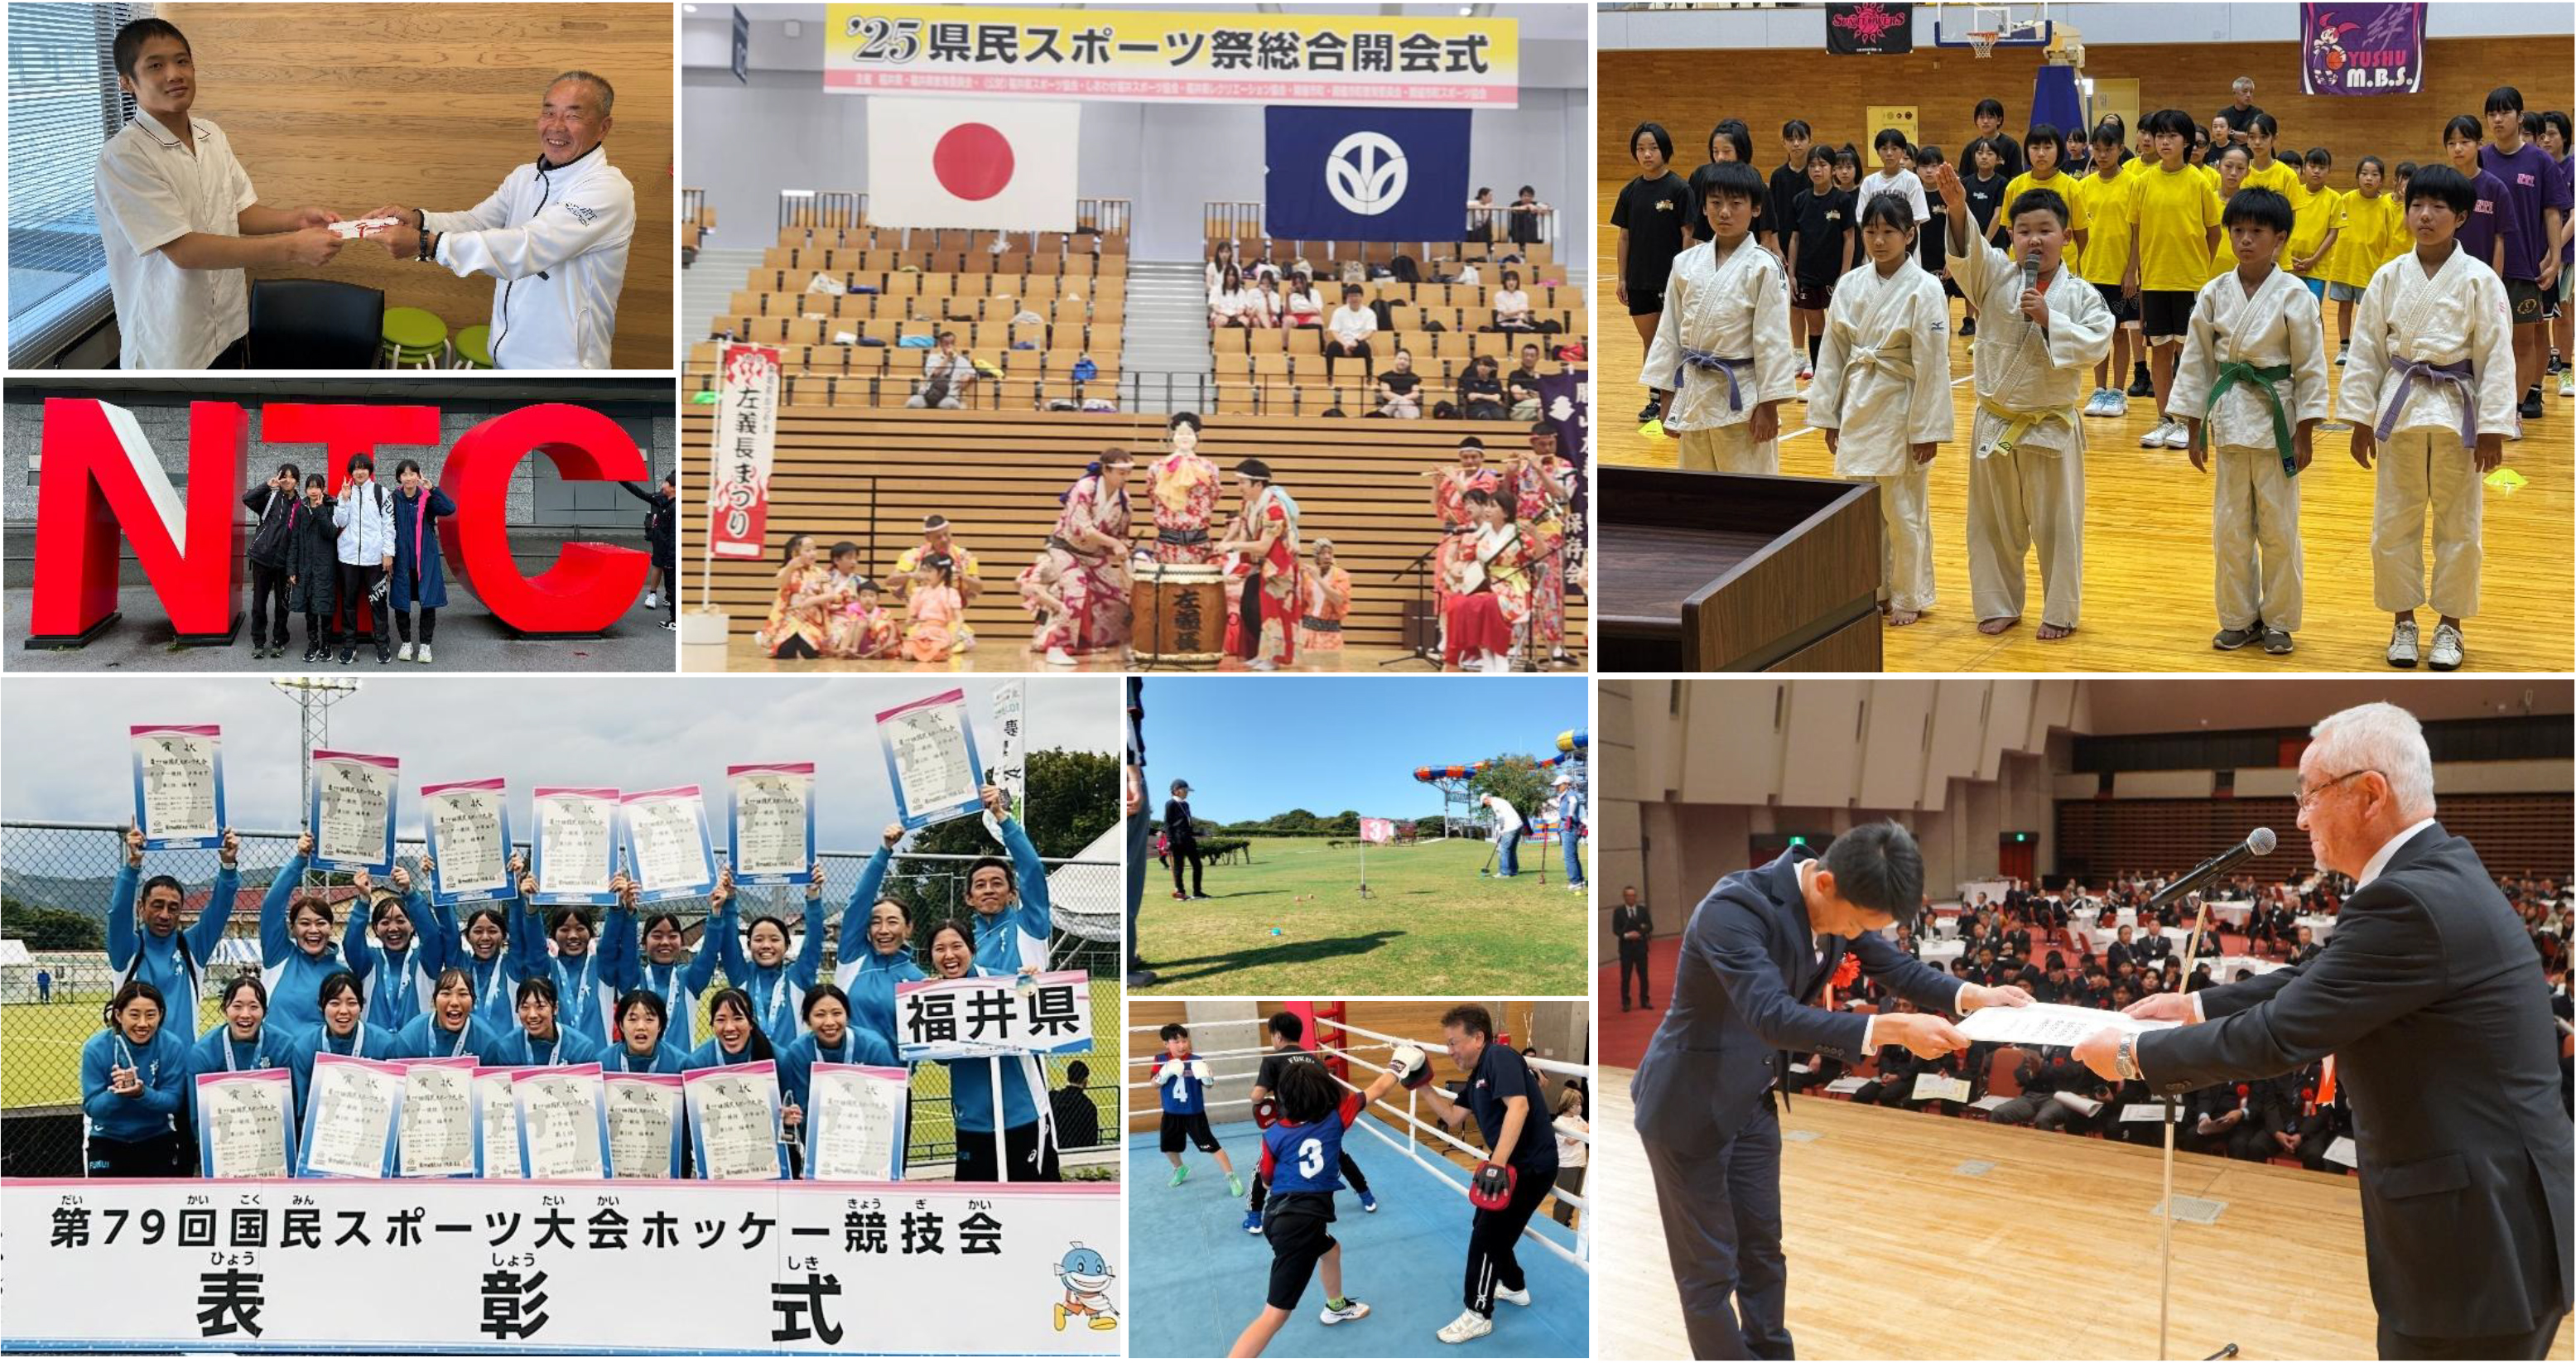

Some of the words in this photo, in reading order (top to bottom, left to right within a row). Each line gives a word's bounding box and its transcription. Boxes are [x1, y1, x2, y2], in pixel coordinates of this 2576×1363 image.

[2347, 50, 2406, 68] YUSHU
[2347, 66, 2413, 88] M.B.S.
[729, 387, 761, 536] 左義長まつり
[31, 397, 652, 637] NTC
[1368, 821, 1381, 841] 3
[907, 985, 1080, 1043] 福井県
[1172, 1074, 1188, 1103] 4
[1298, 1138, 1325, 1180] 3
[61, 1194, 83, 1206] だい
[187, 1194, 209, 1206] かい
[240, 1195, 261, 1206] こく
[292, 1195, 314, 1206] みん
[542, 1195, 565, 1206] たい
[597, 1195, 619, 1206] かい
[847, 1198, 881, 1210] きょう
[915, 1199, 927, 1210] ぎ
[968, 1199, 992, 1211] かい
[51, 1206, 1003, 1255] 第79回国民スポーツ大会ホッケー競技会
[210, 1251, 254, 1266] ひょう
[493, 1252, 536, 1268] しょう
[788, 1255, 819, 1271] しき
